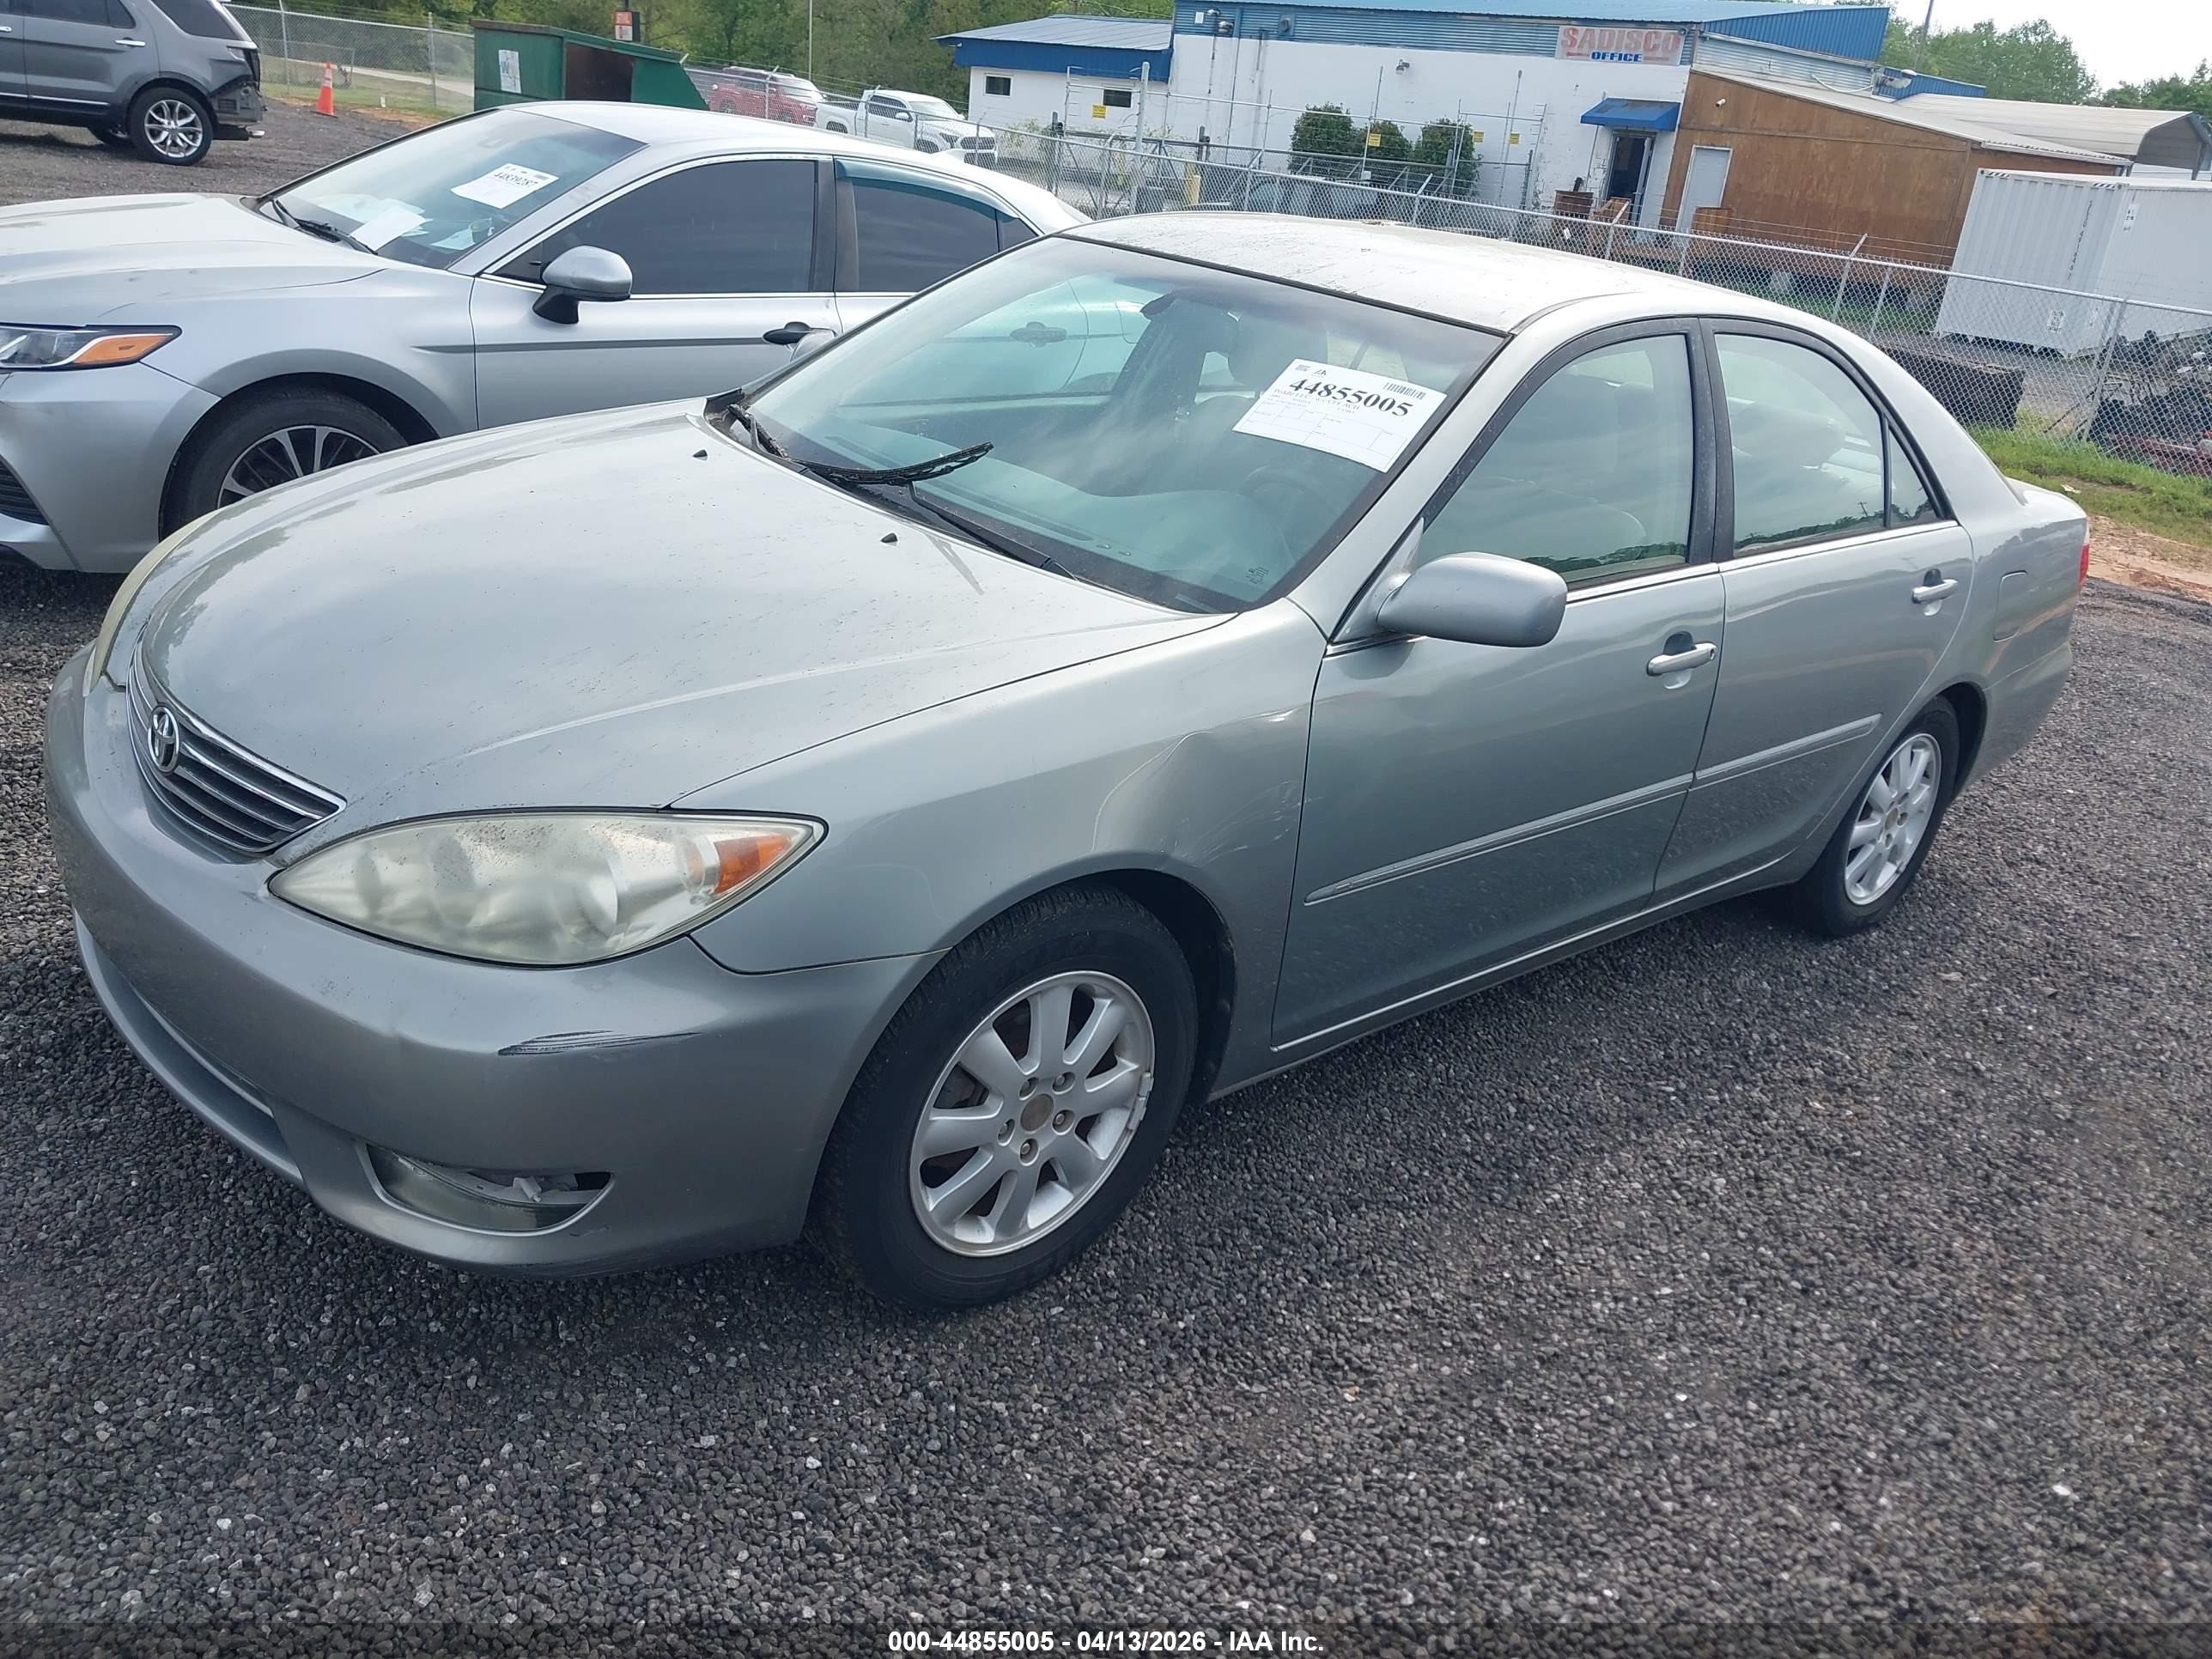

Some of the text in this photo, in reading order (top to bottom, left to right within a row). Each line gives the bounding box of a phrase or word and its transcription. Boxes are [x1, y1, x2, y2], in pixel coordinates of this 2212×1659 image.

[1561, 27, 1680, 53] SADISCO
[1591, 52, 1643, 62] OFFICE
[1289, 379, 1413, 416] 44855005
